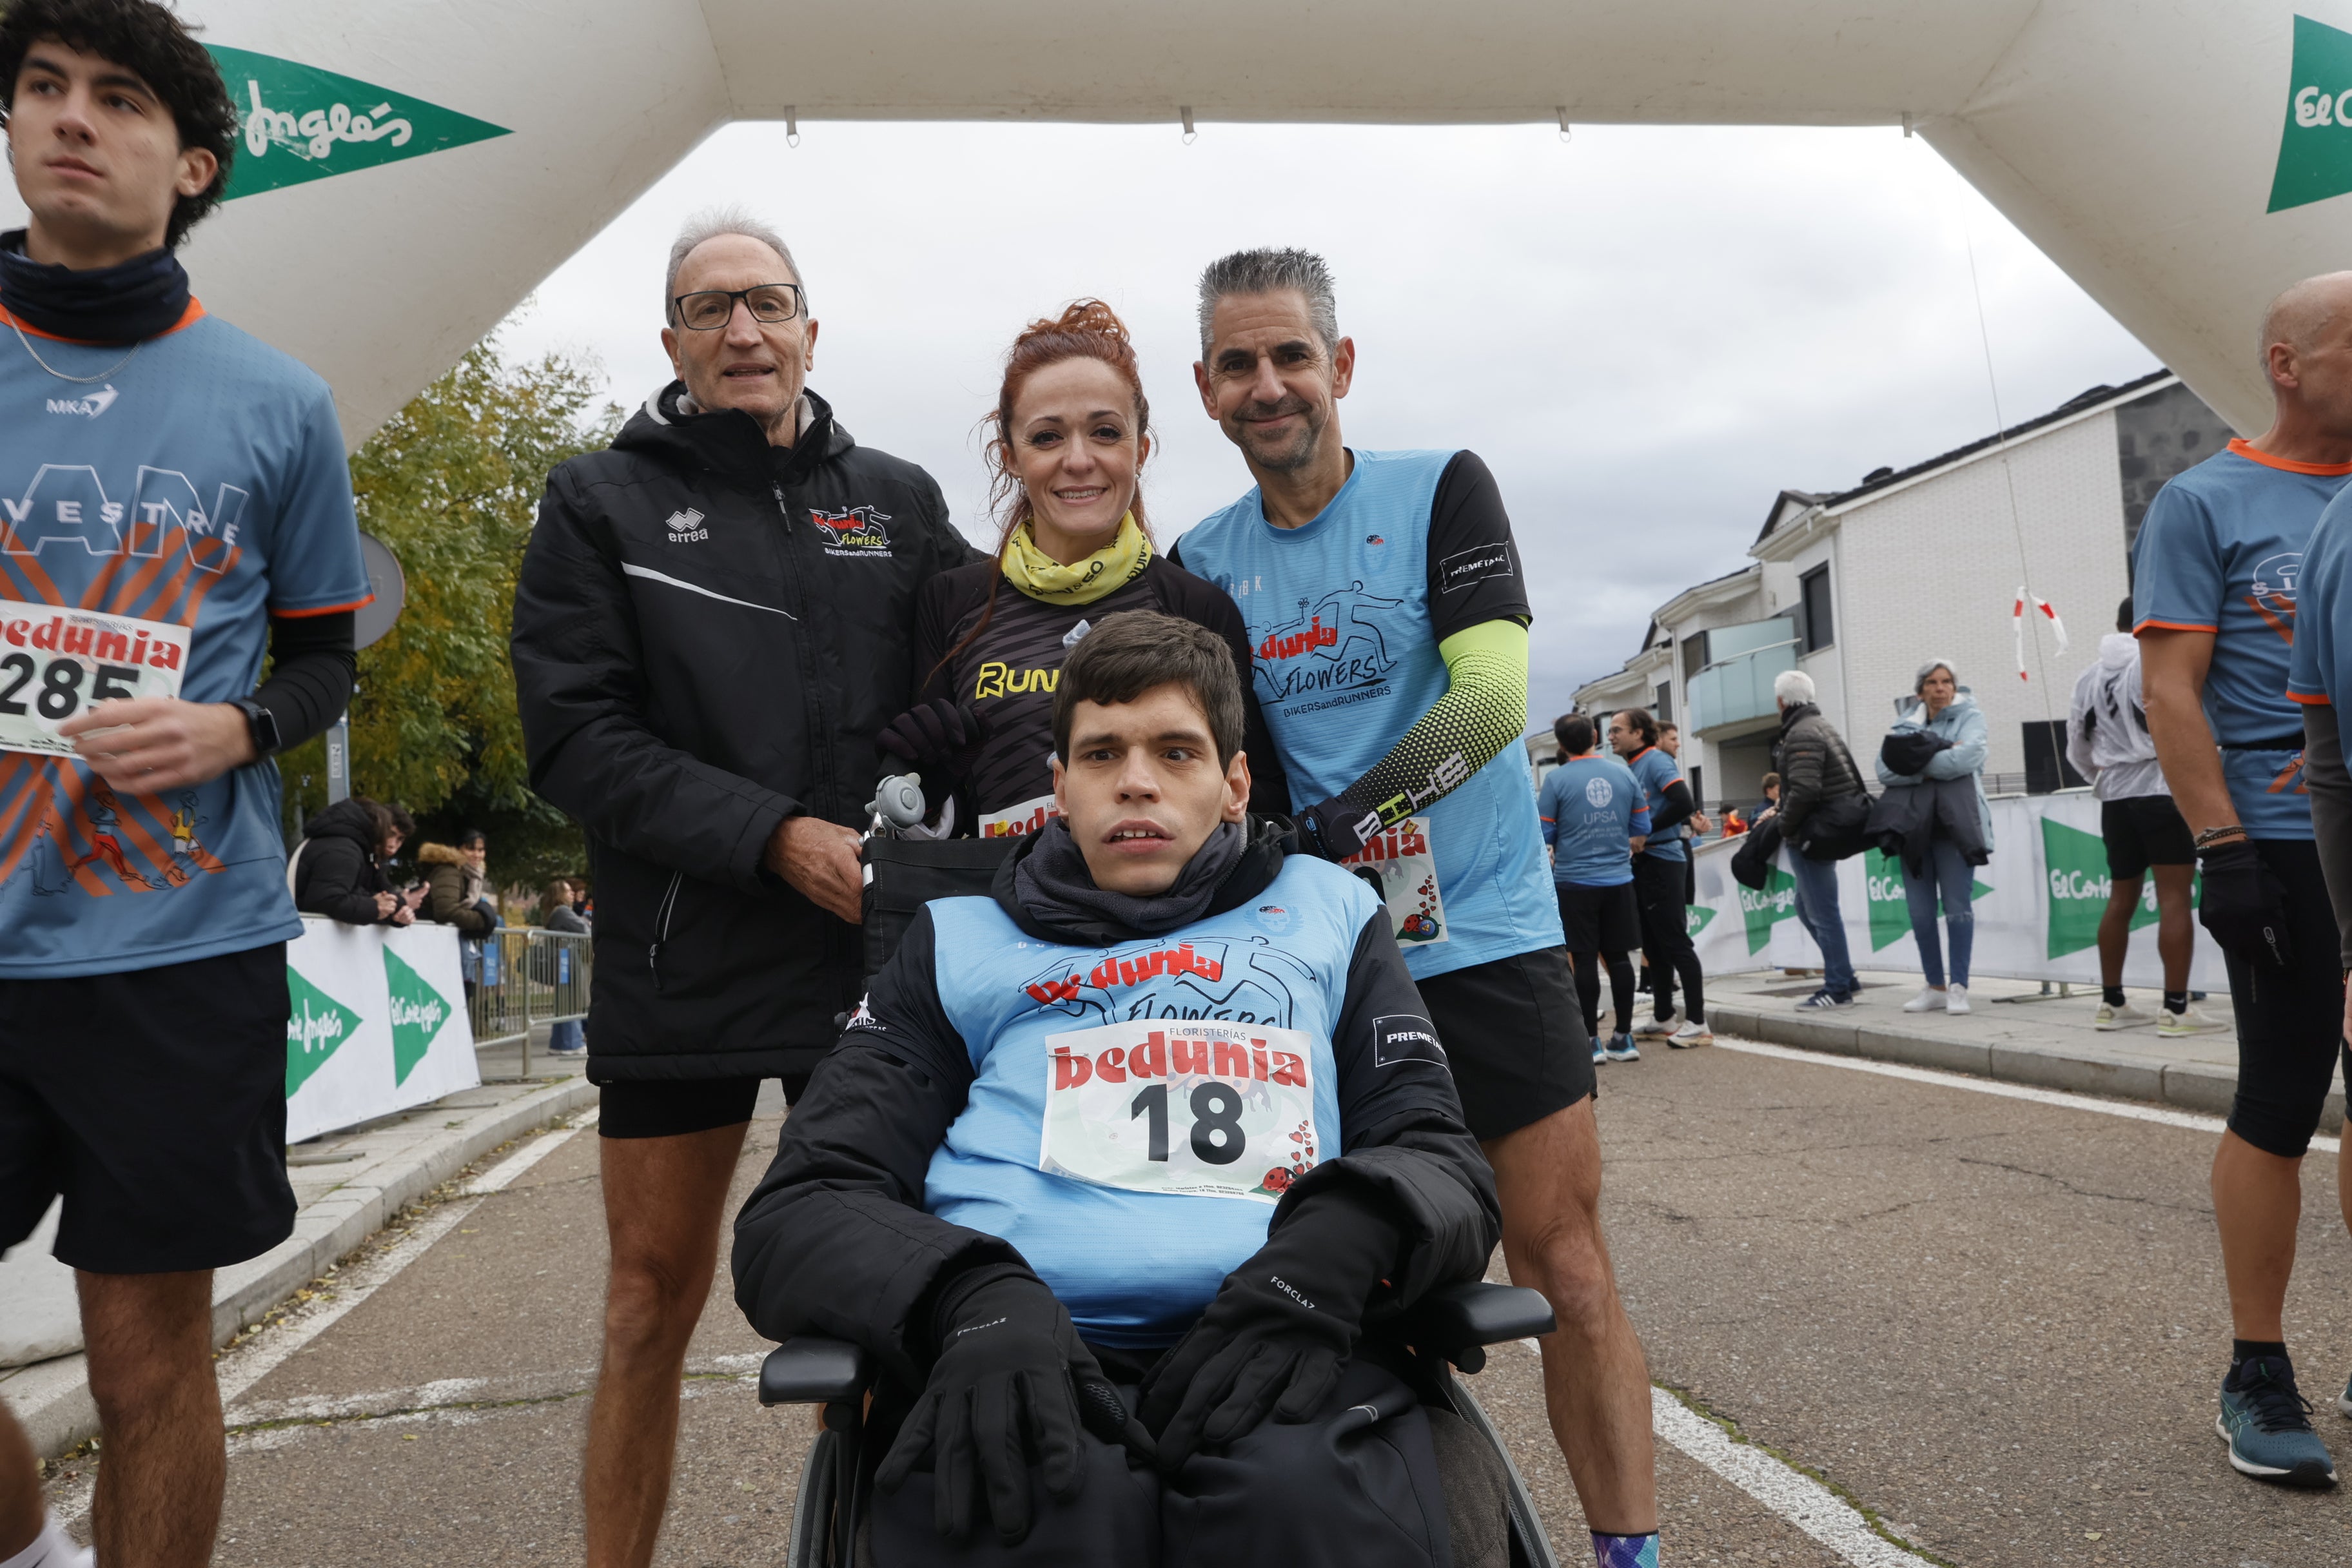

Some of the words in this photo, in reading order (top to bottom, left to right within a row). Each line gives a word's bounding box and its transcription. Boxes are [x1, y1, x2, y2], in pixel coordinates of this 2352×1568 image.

[46, 398, 94, 415] MKA
[841, 533, 883, 546] FLOWERS
[0, 615, 183, 671] edunia
[975, 662, 1060, 700] RUN
[1285, 655, 1377, 696] FLOWERS
[1284, 685, 1391, 718] BIKERSandRUNNERS
[1583, 810, 1618, 825] UPSA
[1169, 1026, 1247, 1041] FLORISTERÍAS
[1054, 1031, 1307, 1091] bedunia
[1131, 1081, 1246, 1166] 18
[1269, 1275, 1315, 1309] FORCLAZ
